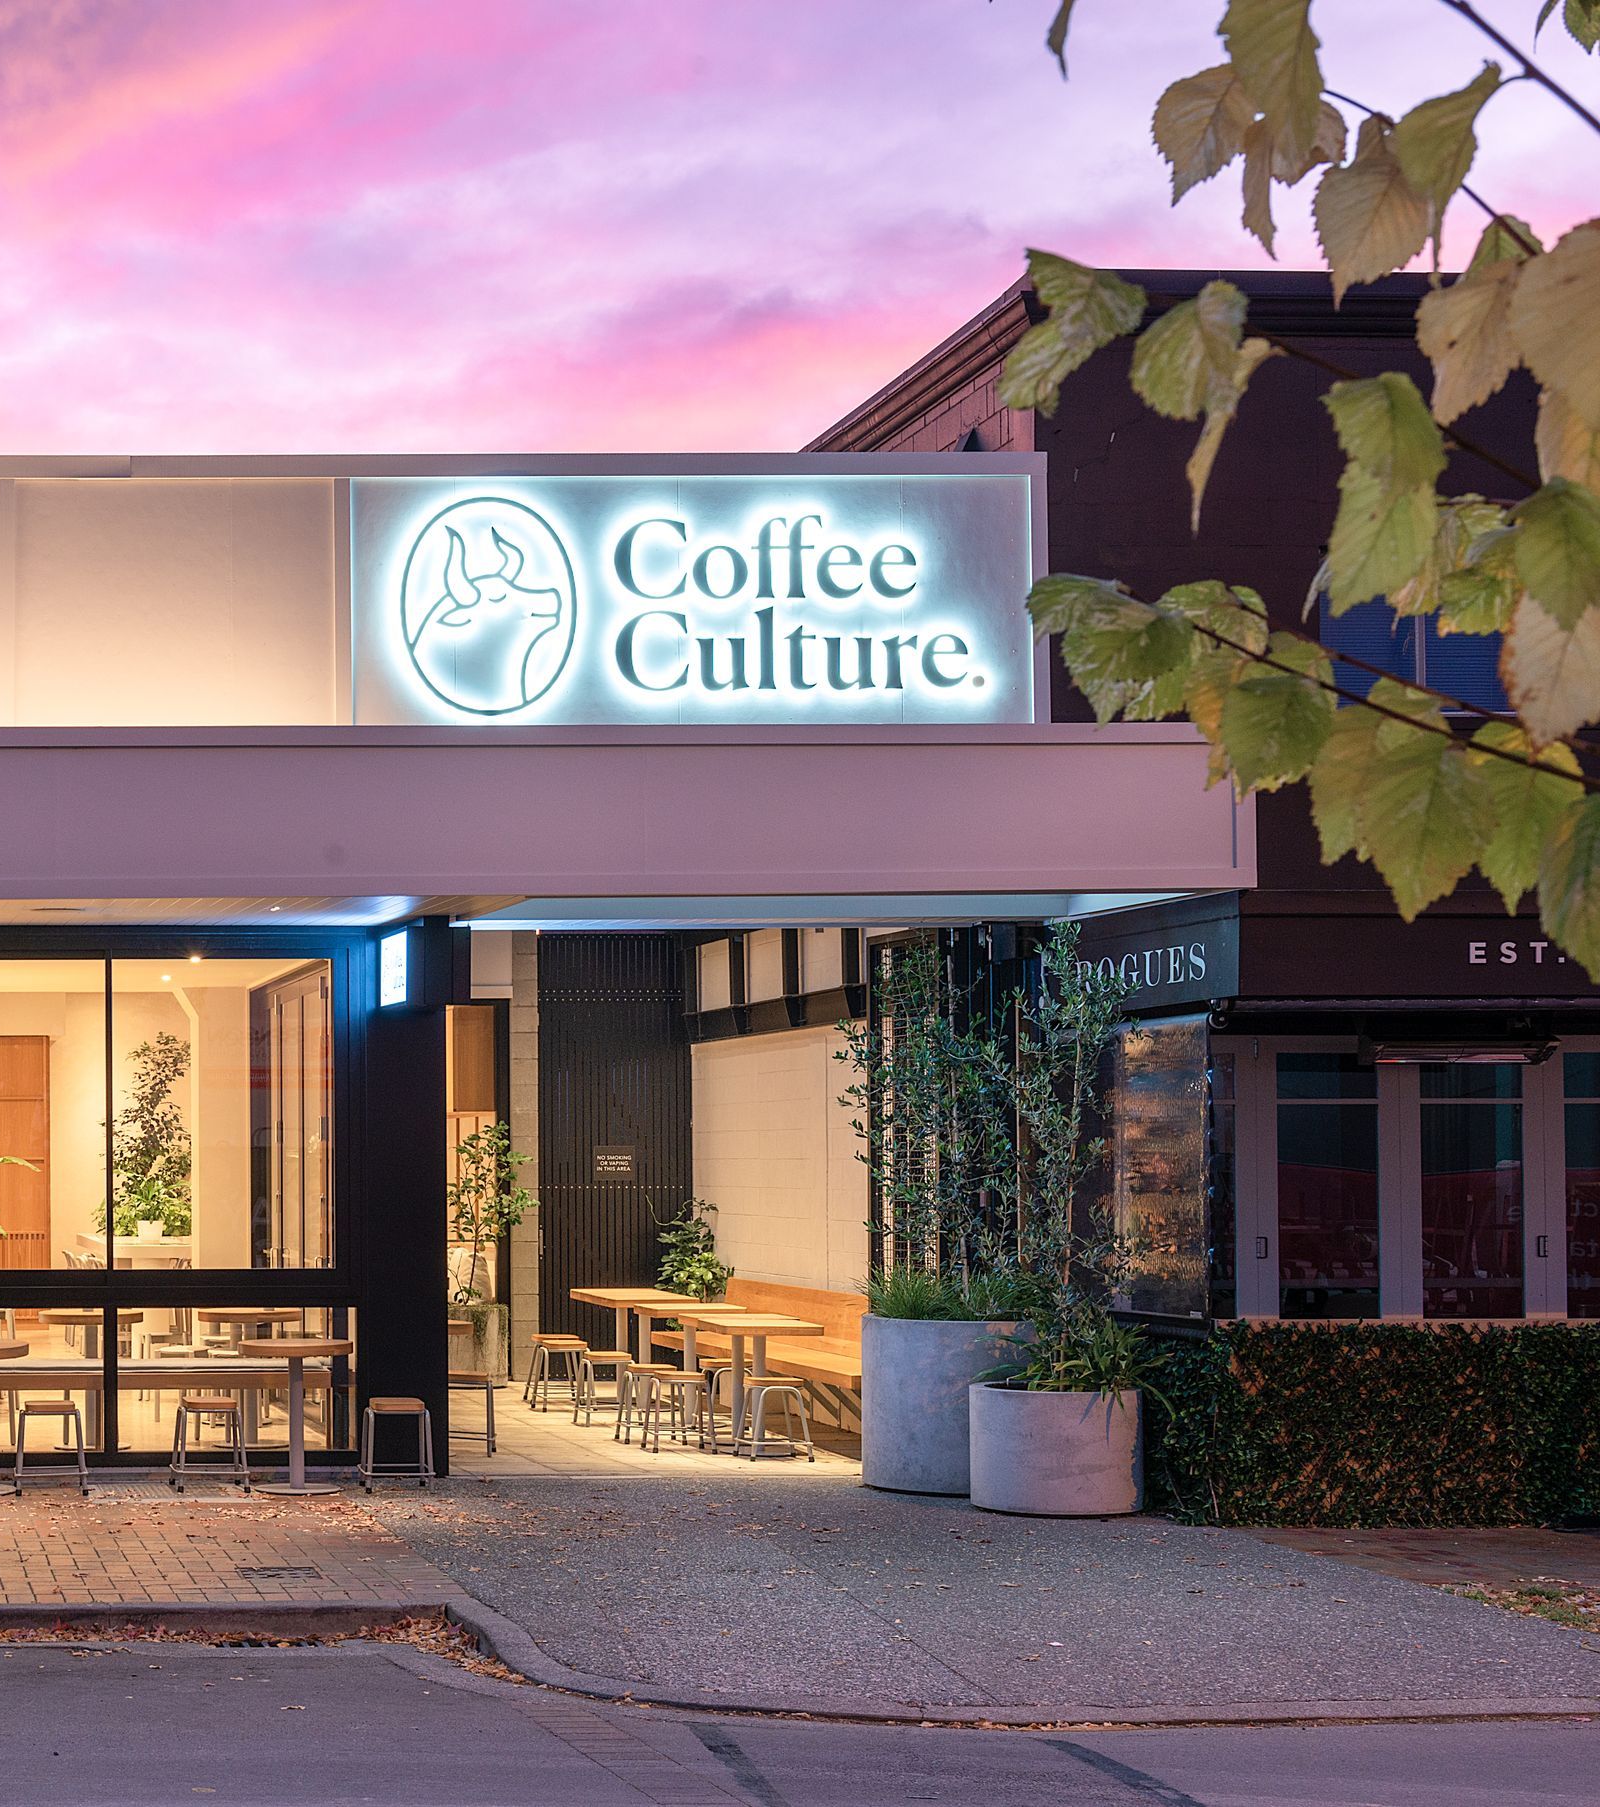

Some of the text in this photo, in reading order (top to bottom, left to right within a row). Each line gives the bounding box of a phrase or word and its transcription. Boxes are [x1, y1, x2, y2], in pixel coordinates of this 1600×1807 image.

[613, 514, 918, 600] Coffee
[614, 605, 987, 693] Culture.
[1074, 942, 1206, 995] ROGUES
[1469, 941, 1565, 964] EST.
